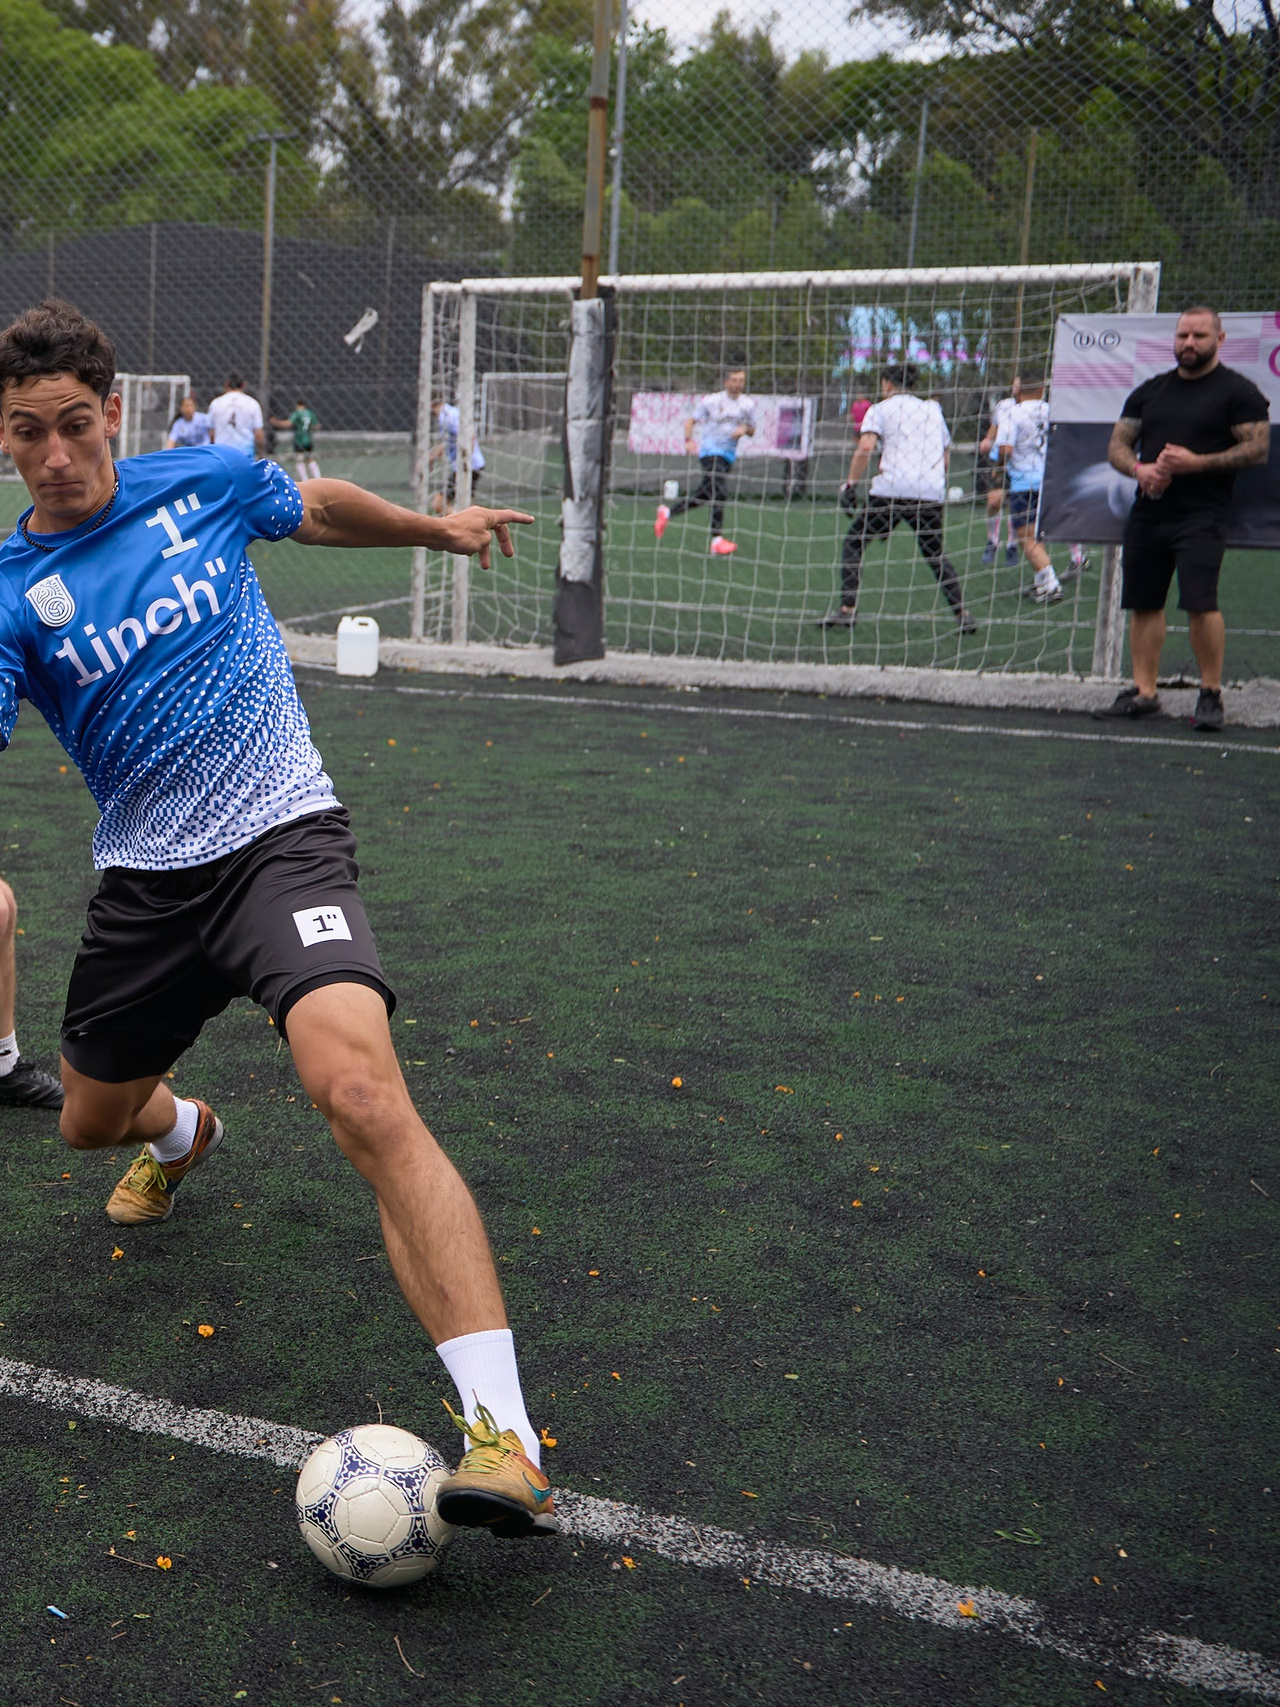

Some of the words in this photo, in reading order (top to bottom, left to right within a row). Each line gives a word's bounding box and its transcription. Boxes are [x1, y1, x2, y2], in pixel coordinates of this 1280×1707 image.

[145, 493, 201, 559] 1"
[55, 557, 227, 687] 1inch"
[312, 914, 337, 933] 1"
